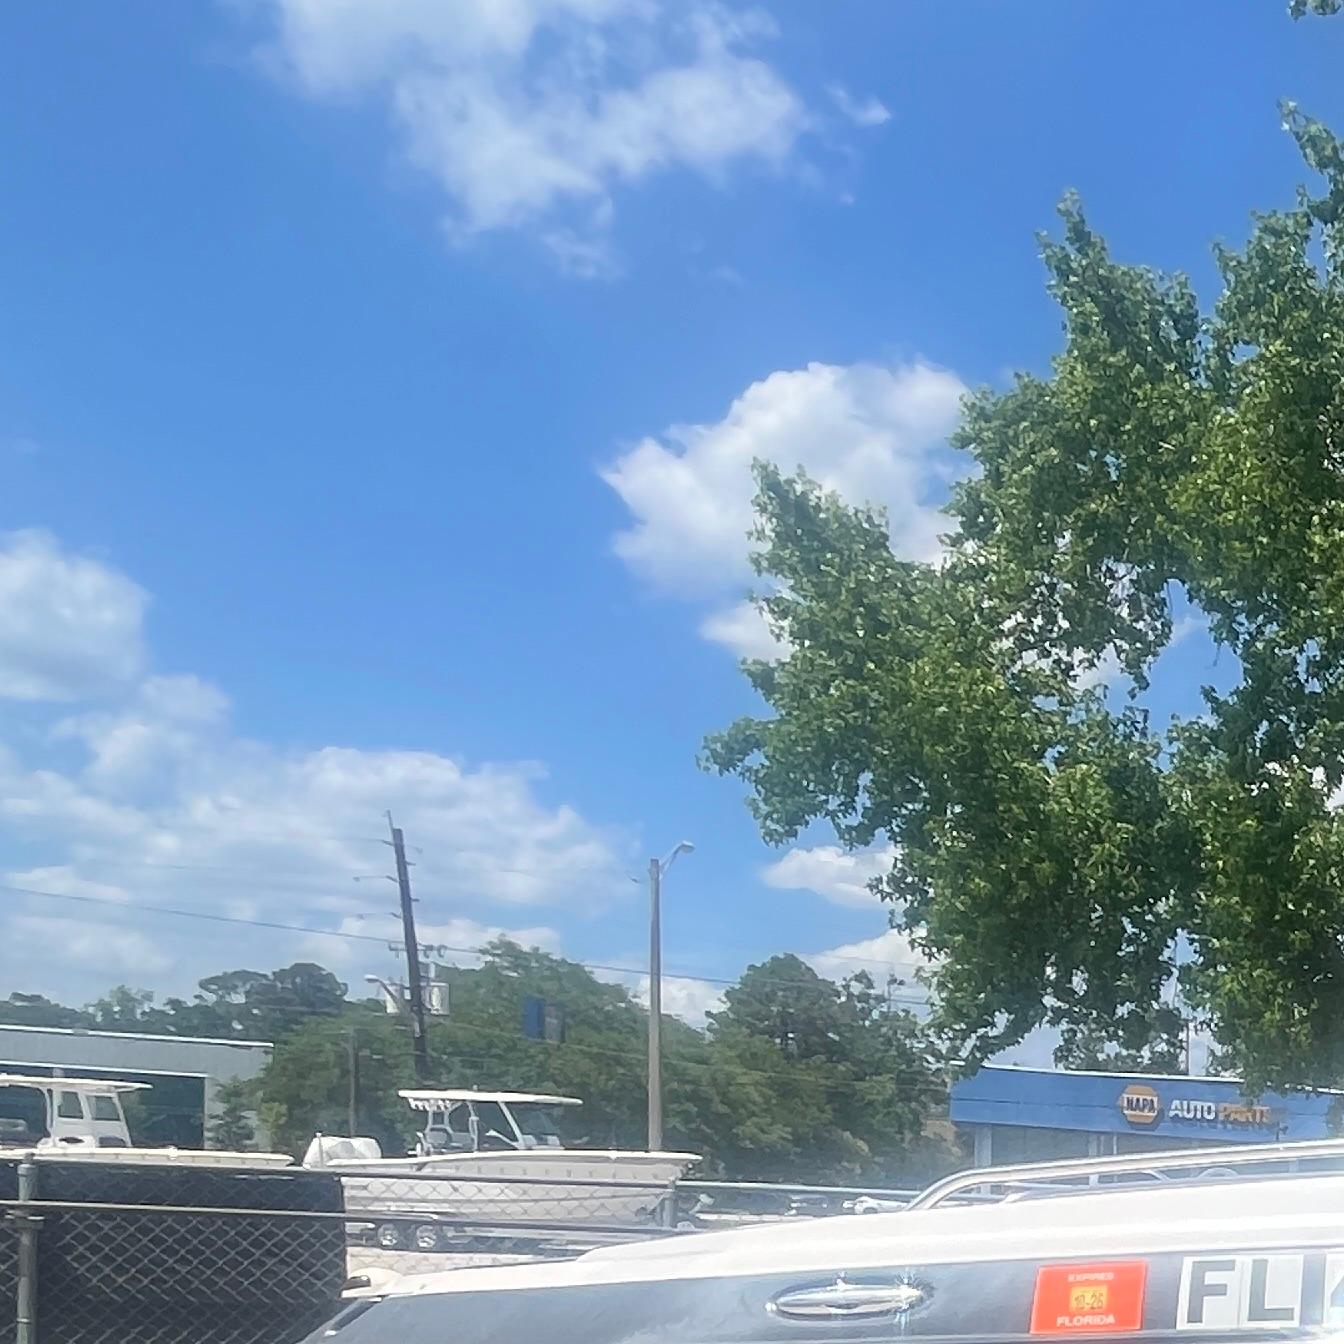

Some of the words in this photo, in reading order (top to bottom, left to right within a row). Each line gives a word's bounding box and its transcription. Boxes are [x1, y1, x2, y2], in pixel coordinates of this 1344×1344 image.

[1126, 1097, 1155, 1114] NAPA
[1168, 1100, 1216, 1120] AUTO
[1186, 1258, 1295, 1324] FL
[1056, 1314, 1116, 1327] FLORIDA
